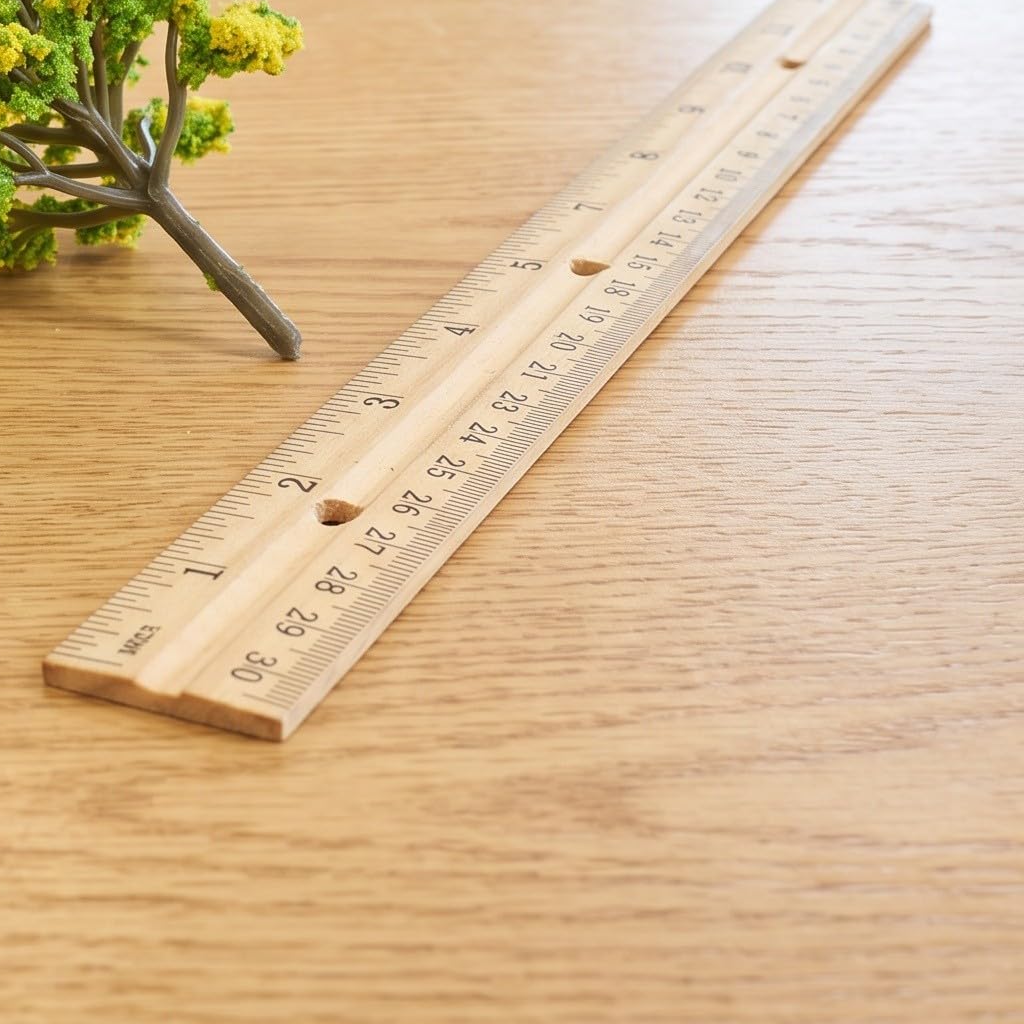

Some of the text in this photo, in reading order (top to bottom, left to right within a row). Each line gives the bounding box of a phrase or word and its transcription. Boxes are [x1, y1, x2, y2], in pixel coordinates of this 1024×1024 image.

[694, 187, 723, 203] 12
[672, 209, 702, 225] 13
[650, 231, 681, 249] 14
[627, 254, 658, 271] 15
[604, 279, 635, 297] 18
[579, 305, 610, 324] 19
[550, 332, 584, 352] 20
[183, 567, 225, 581] 1
[278, 477, 317, 493] 2
[363, 396, 400, 409] 3
[444, 323, 476, 337] 4
[510, 261, 542, 271] 5
[573, 202, 603, 213] 7
[630, 151, 658, 161] 8
[521, 360, 557, 382] 21
[492, 390, 528, 413] 23
[460, 421, 497, 445] 24
[427, 455, 465, 480] 25
[392, 490, 432, 517] 26
[354, 527, 396, 555] 27
[315, 566, 357, 595] 28
[276, 607, 318, 637] 29
[231, 650, 277, 684] 30
